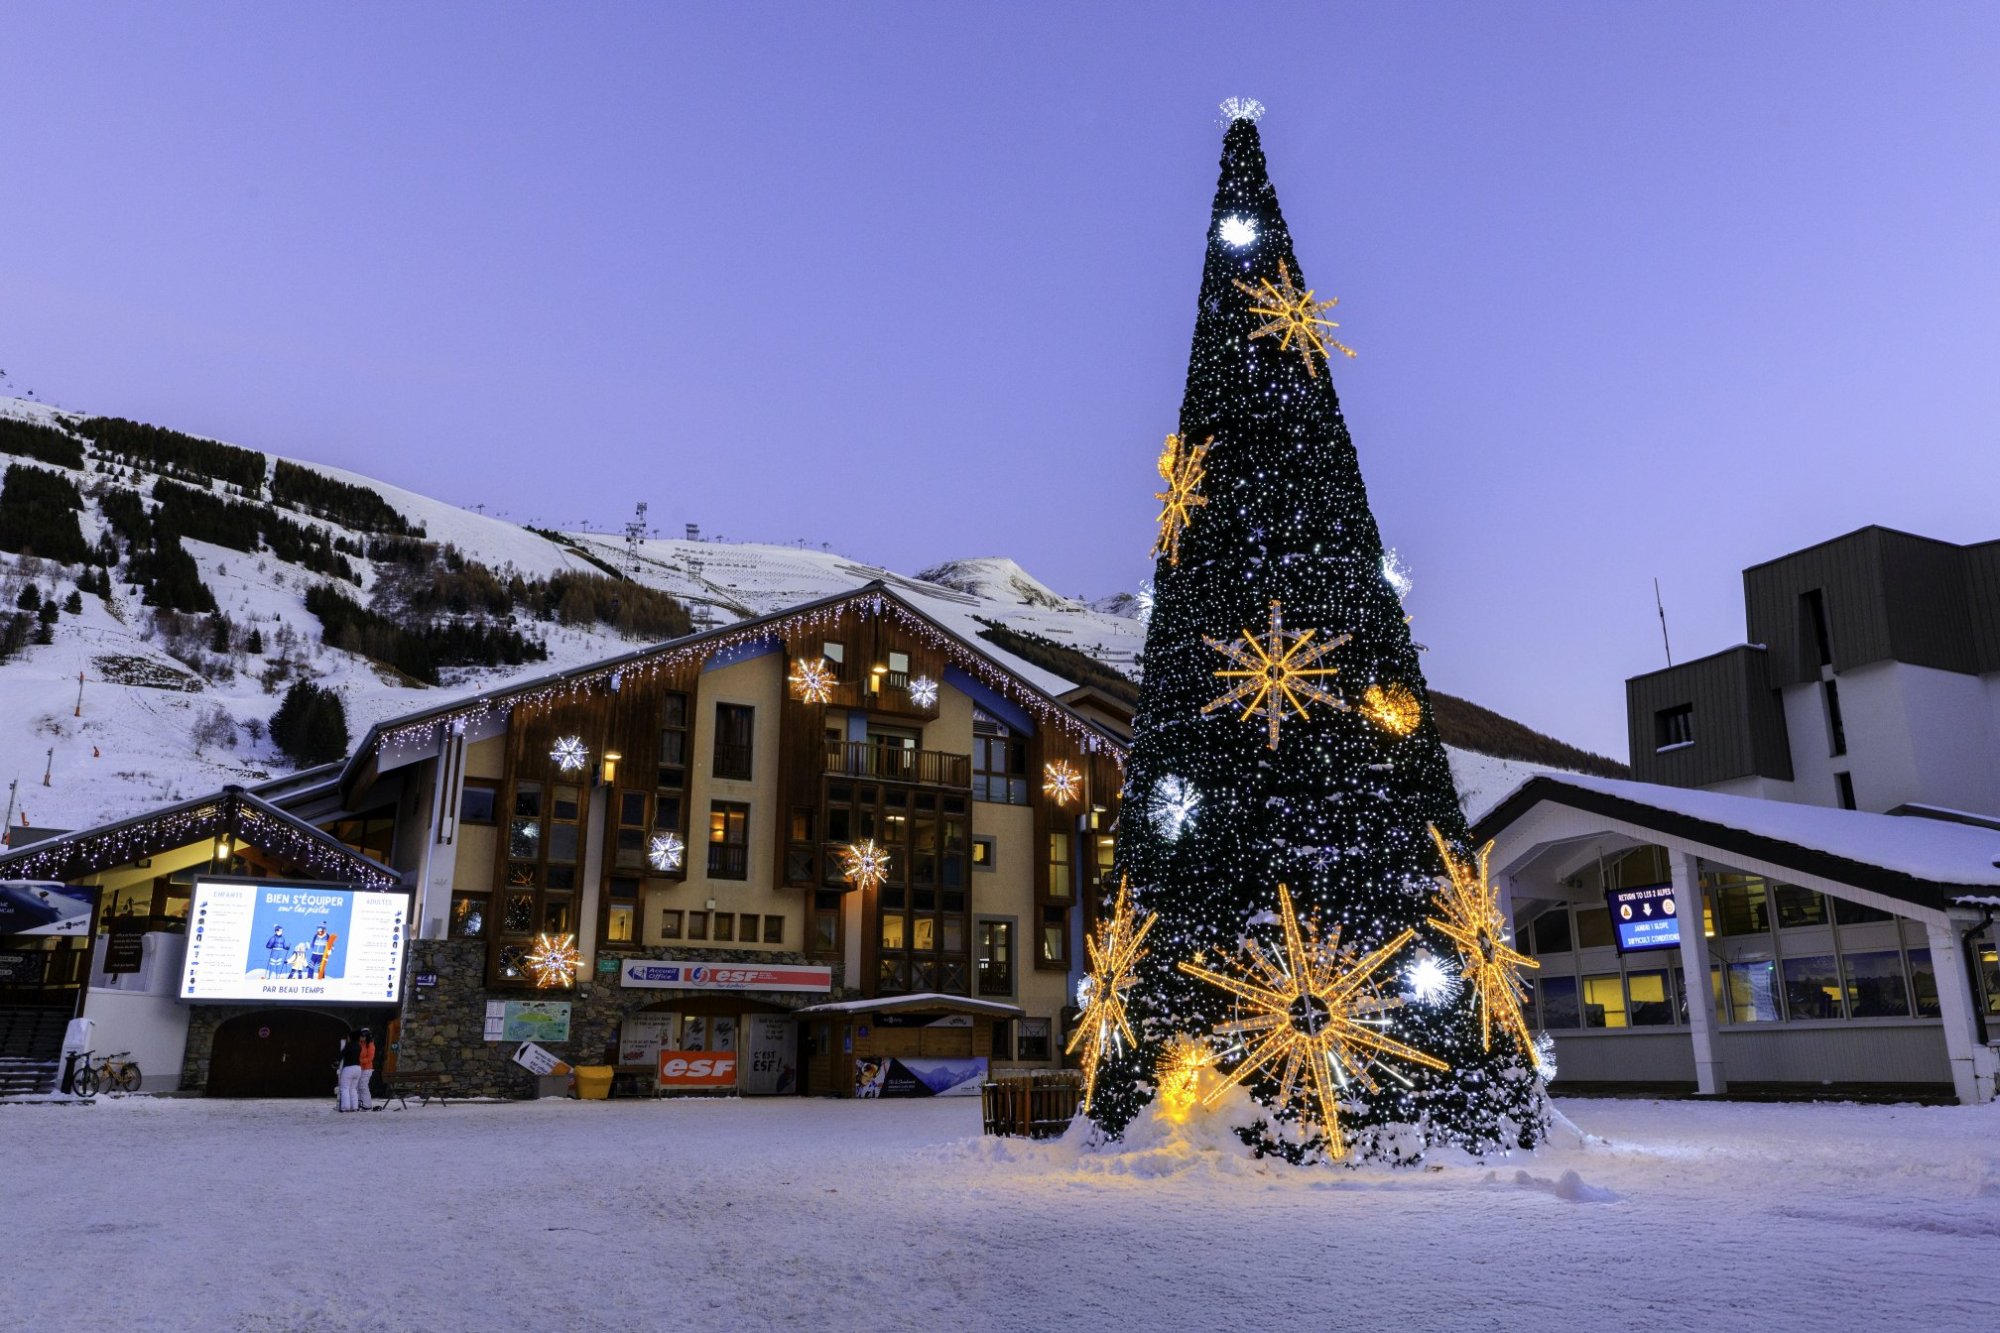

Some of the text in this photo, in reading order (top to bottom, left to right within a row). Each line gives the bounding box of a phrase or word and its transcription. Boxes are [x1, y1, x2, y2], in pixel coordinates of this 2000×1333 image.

[213, 891, 243, 899] ENFANTS
[1636, 891, 1643, 899] TO
[1643, 890, 1651, 899] LES
[1656, 887, 1671, 897] ALPES
[266, 892, 344, 907] BIEN S'ÉQUIPER
[366, 898, 393, 906] ADULTES
[294, 904, 305, 913] les
[304, 905, 330, 916] pistes
[1627, 933, 1680, 945] DIFFICULT CONDITIONS
[262, 985, 325, 994] PAR BEAU TEMPS
[754, 1050, 777, 1060] C'EST
